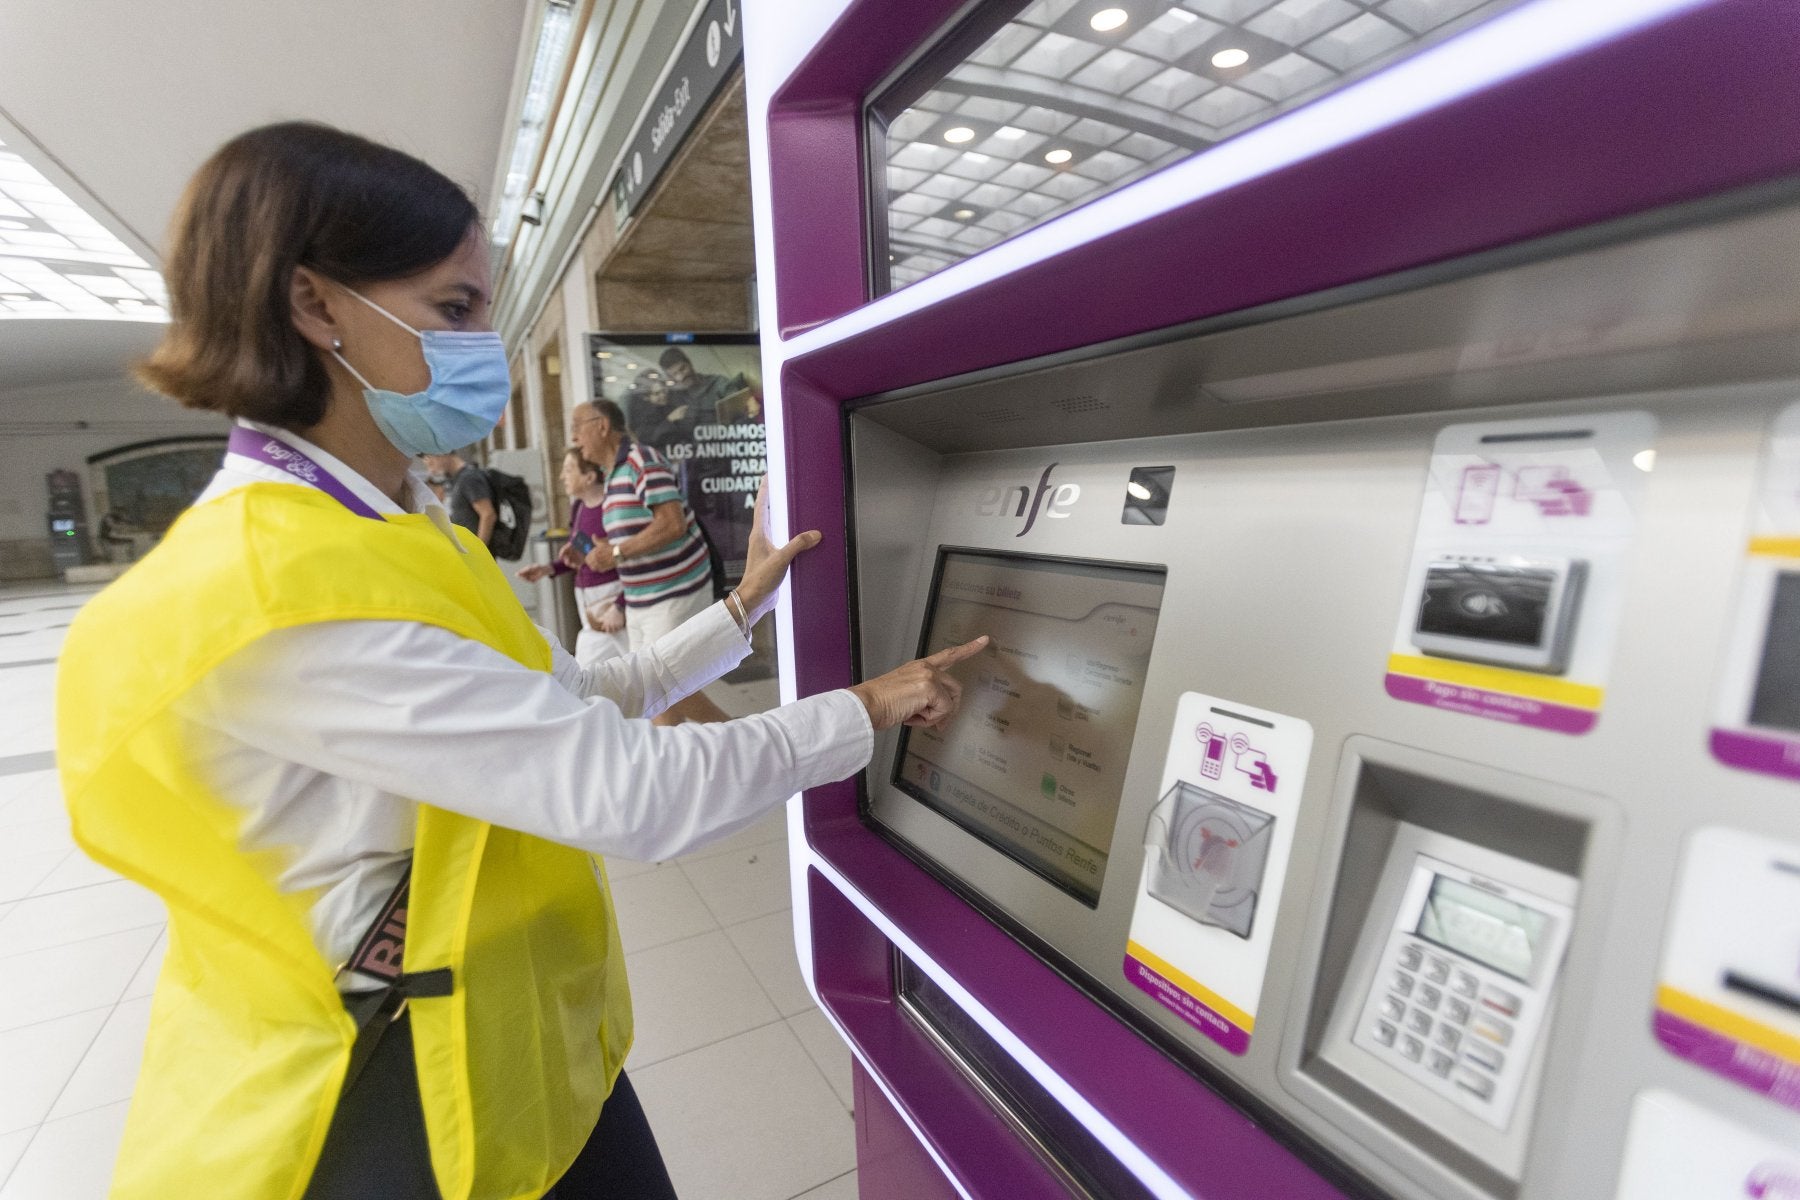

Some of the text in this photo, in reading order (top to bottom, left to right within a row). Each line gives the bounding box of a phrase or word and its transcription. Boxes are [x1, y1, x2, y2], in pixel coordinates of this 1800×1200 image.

[693, 424, 765, 440] CUIDAMOS
[666, 441, 766, 459] LOS ANUNCIOS
[731, 459, 767, 474] PARA
[701, 476, 761, 493] CUIDART
[973, 462, 1081, 537] enfe
[985, 586, 995, 596] su
[978, 798, 990, 814] de
[1021, 825, 1029, 835] o
[1029, 827, 1064, 856] Puntos
[1066, 848, 1098, 874] Renfe
[1139, 966, 1230, 1034] Dispositivos sin contacto
